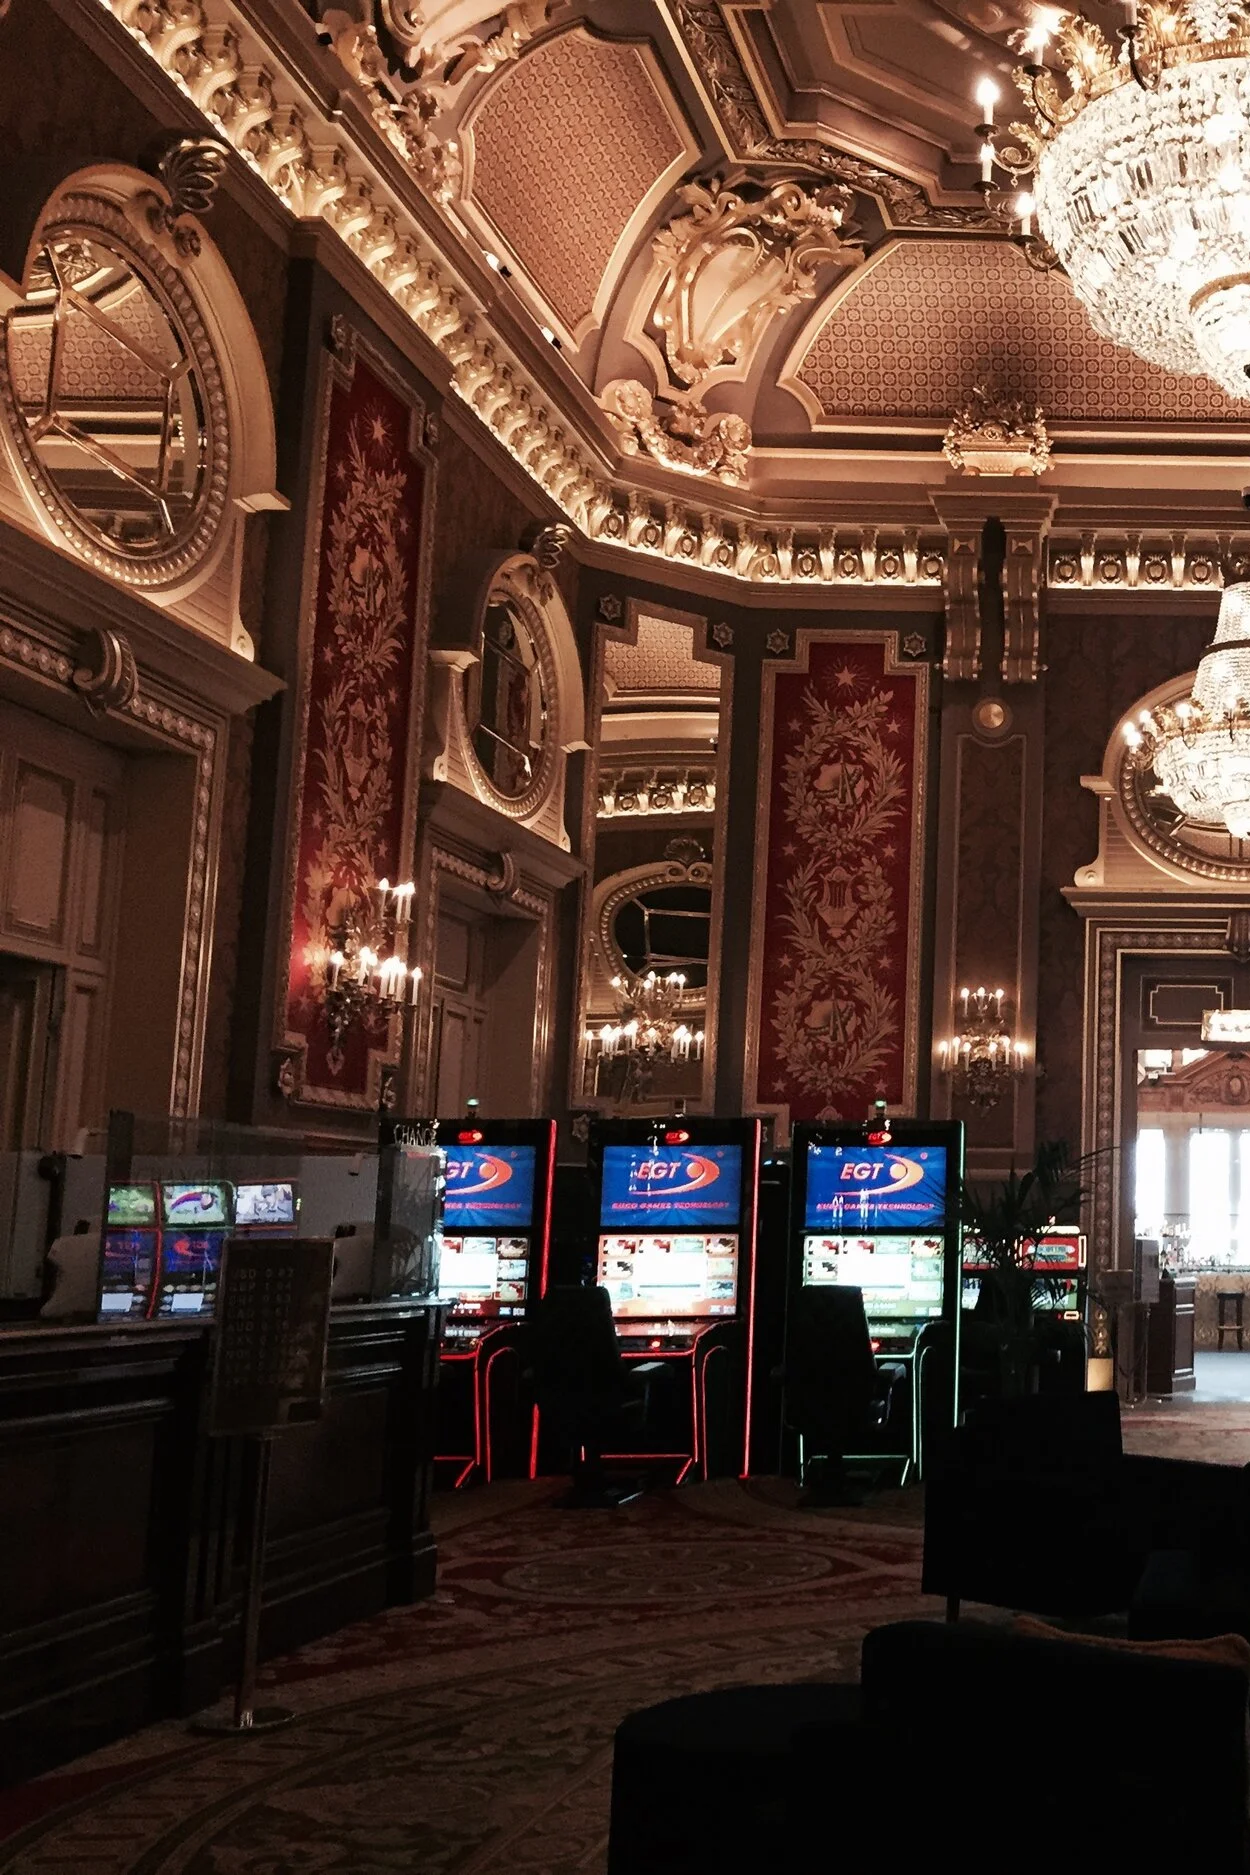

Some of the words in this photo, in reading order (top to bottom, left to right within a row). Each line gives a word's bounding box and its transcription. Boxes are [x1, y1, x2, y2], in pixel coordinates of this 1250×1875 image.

[446, 1161, 474, 1179] GT
[637, 1161, 681, 1180] EGT
[840, 1162, 884, 1180] EGT
